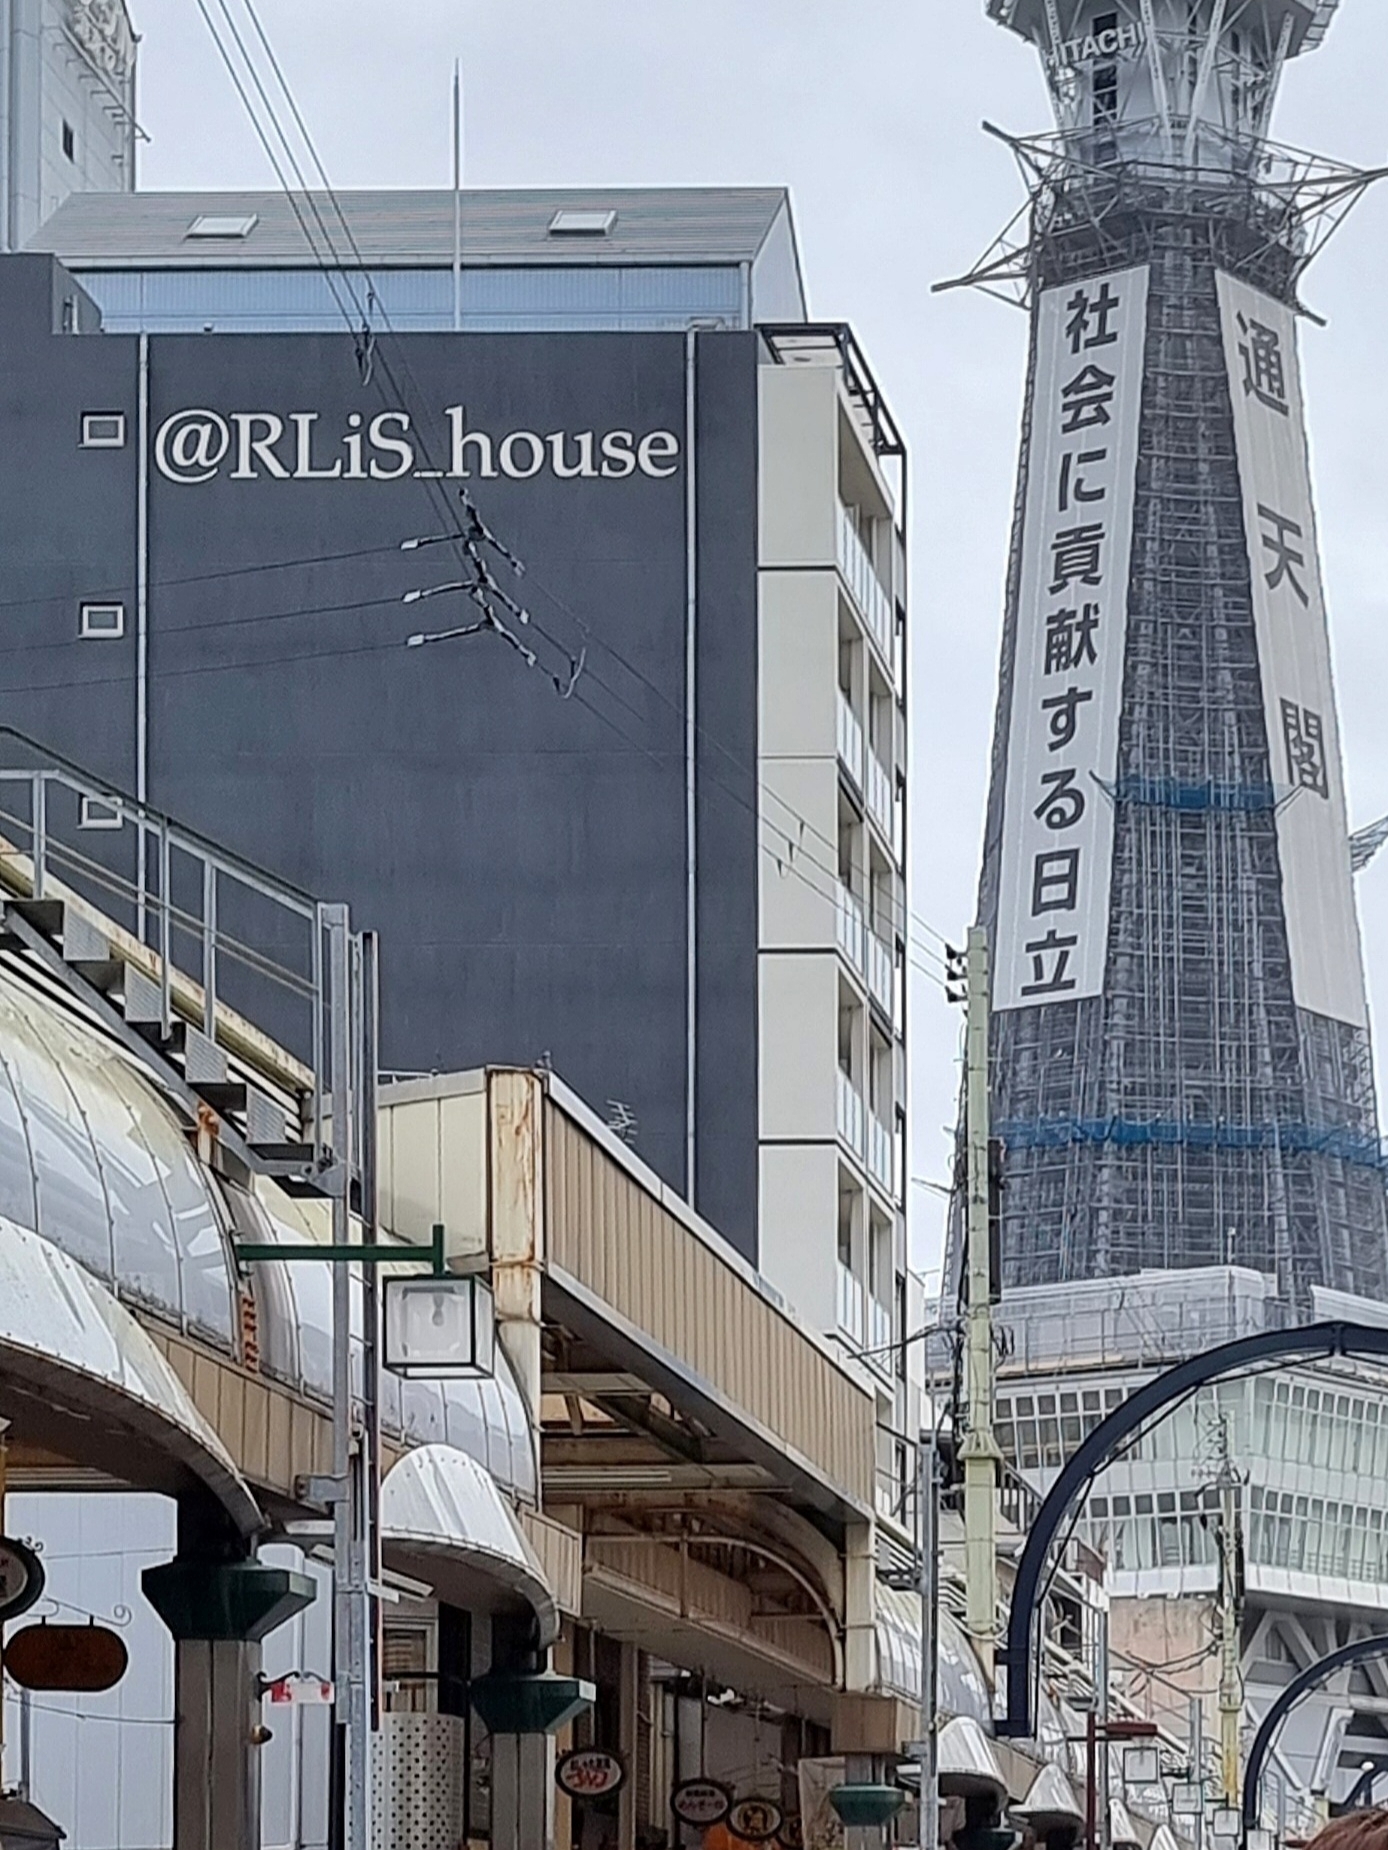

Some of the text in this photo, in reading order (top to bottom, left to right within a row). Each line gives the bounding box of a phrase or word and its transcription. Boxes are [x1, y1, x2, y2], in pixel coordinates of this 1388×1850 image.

[1043, 22, 1145, 67] HITACHI
[154, 406, 680, 485] @RLiS_house
[1237, 311, 1330, 801] 通天閣
[1019, 282, 1121, 998] 社会に貢献する日立
